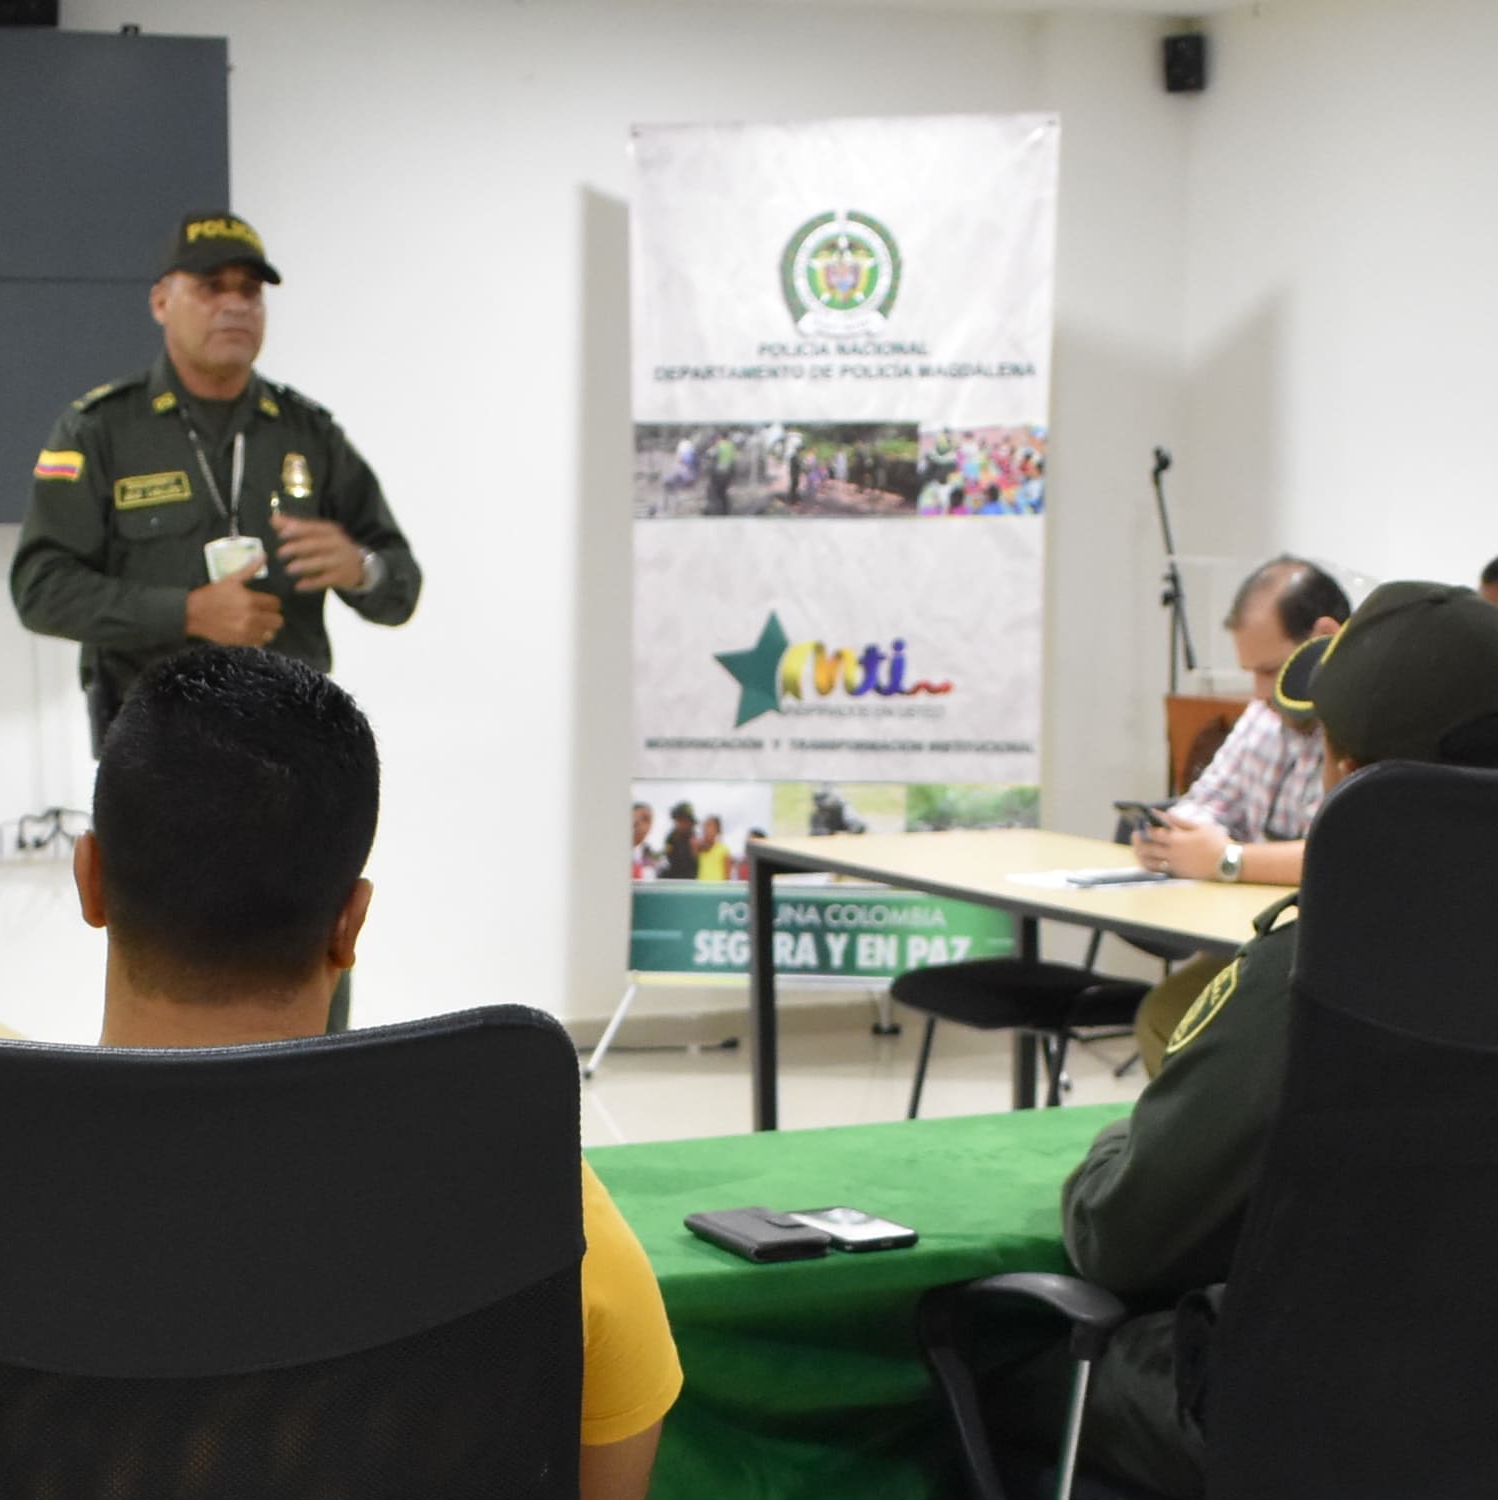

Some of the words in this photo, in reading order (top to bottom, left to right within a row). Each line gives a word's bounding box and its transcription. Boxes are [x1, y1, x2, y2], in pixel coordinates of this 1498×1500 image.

[718, 901, 749, 925] PO
[823, 902, 947, 928] COLOMBIA
[693, 929, 818, 968] SEGRA
[824, 932, 849, 968] Y
[855, 932, 899, 969] EN
[904, 935, 973, 970] PAZ
